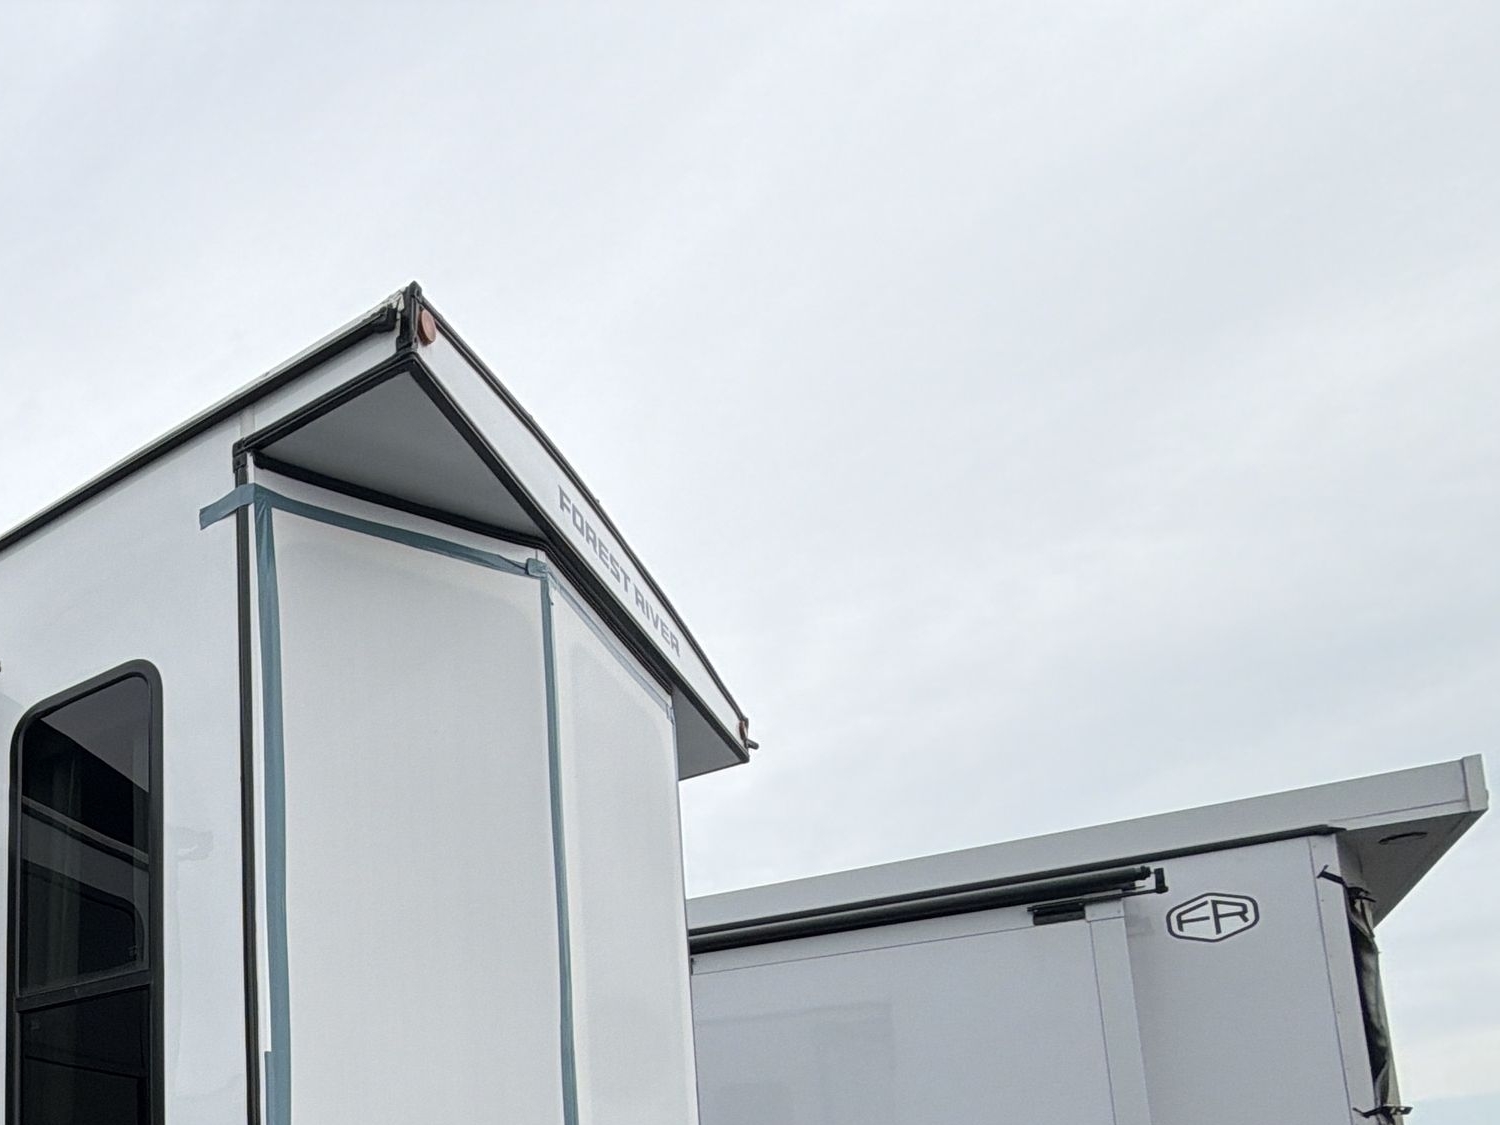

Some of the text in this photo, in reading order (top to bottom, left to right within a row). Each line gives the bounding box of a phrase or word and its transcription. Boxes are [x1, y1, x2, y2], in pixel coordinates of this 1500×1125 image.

[558, 484, 681, 658] FOREST RIVER
[1176, 899, 1249, 935] FR
